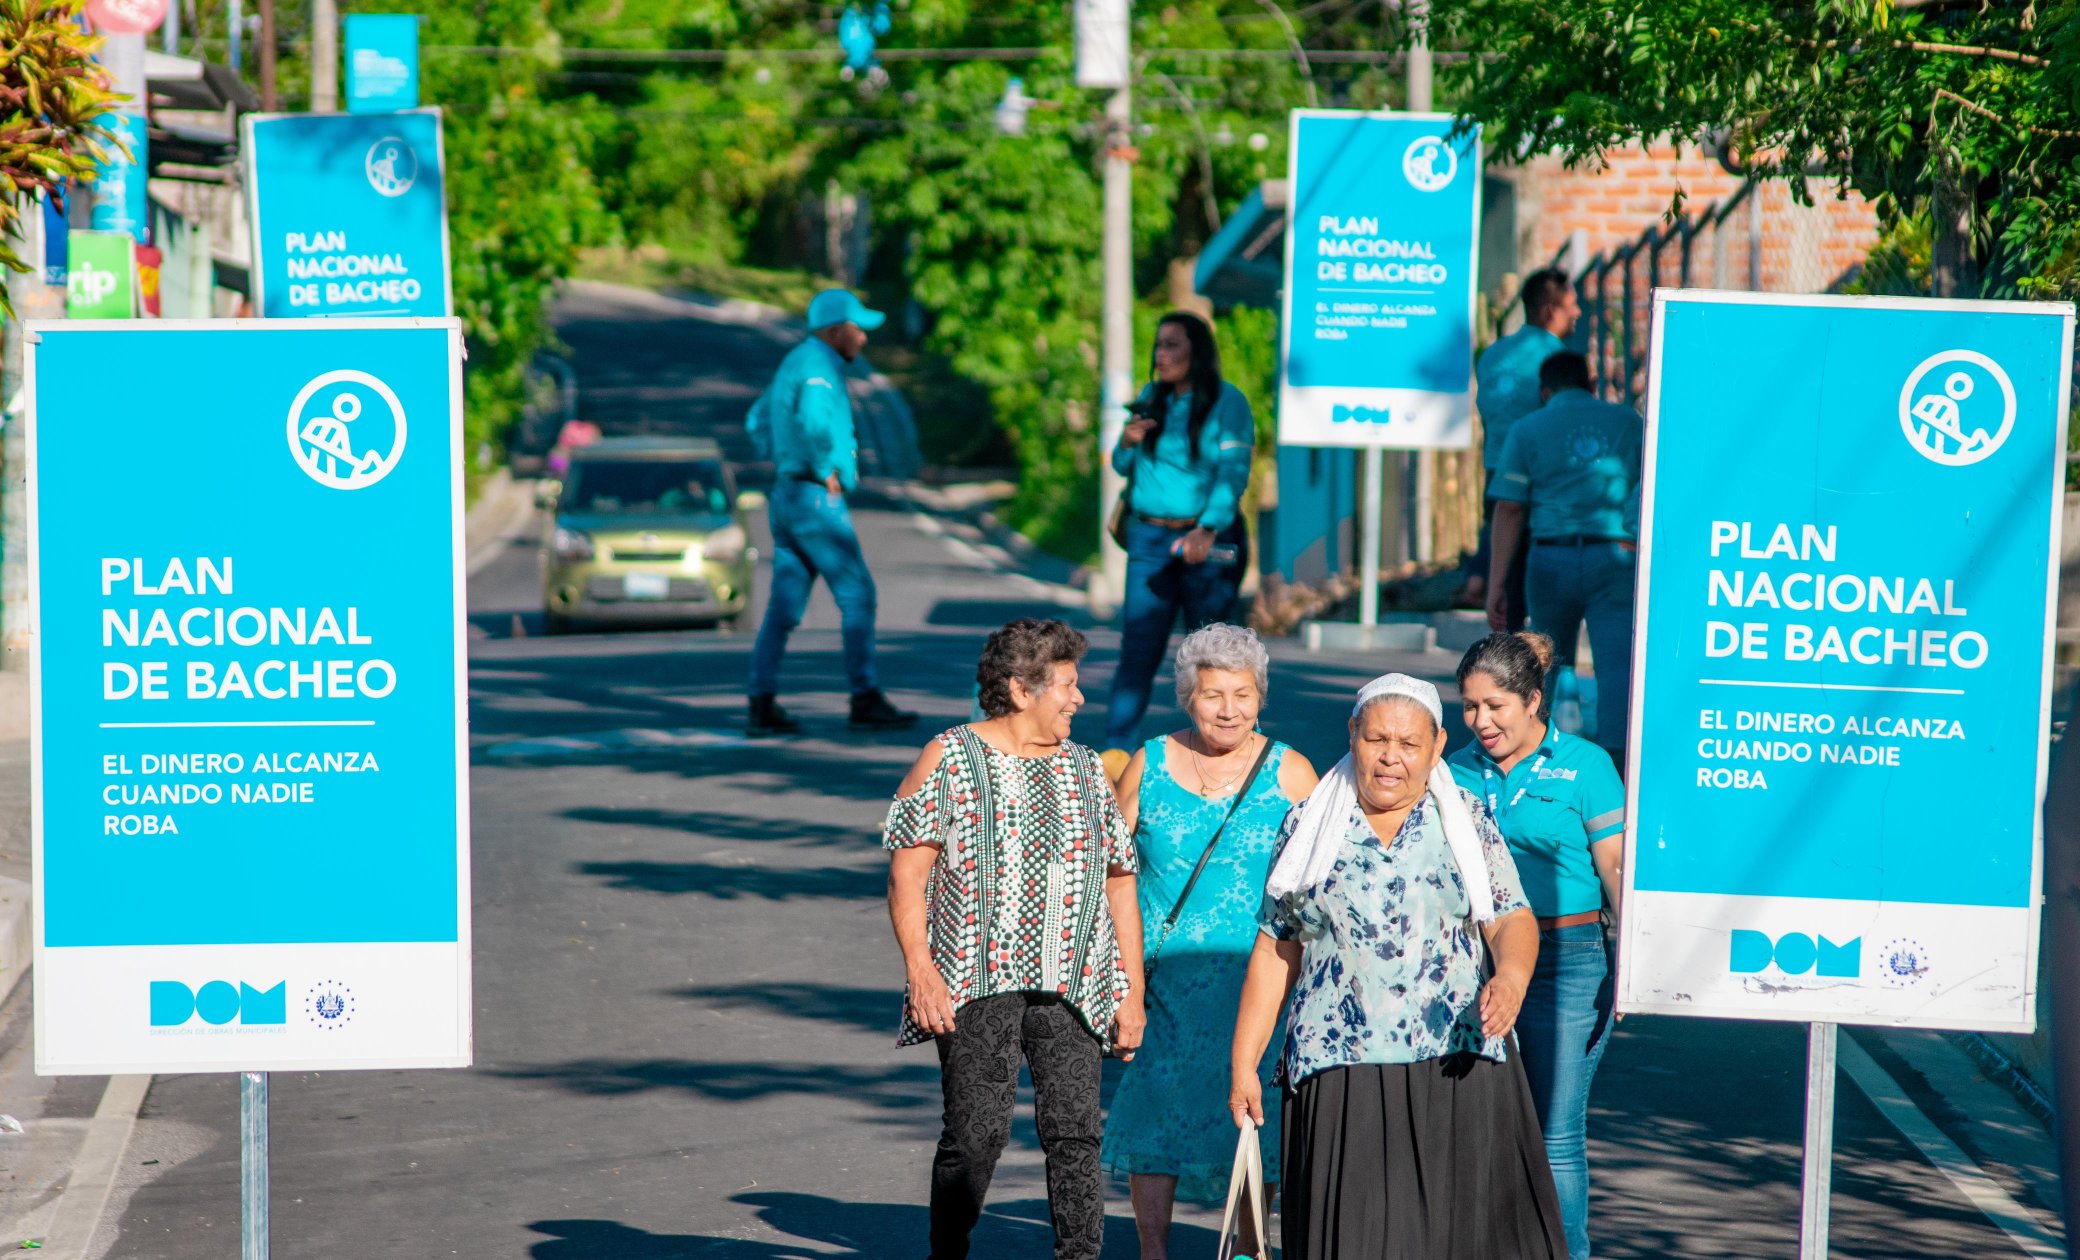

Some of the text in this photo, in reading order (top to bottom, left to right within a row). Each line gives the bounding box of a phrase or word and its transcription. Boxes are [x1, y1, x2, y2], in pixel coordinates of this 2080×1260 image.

[1319, 216, 1378, 236] PLAN
[285, 230, 347, 254] PLAN
[1318, 238, 1436, 260] NACIONAL
[287, 253, 408, 279] NACIONAL
[1317, 261, 1448, 285] DE BACHEO
[289, 278, 421, 307] DE BACHEO
[1711, 520, 1837, 561] PLAN
[102, 556, 233, 595] PLAN
[1708, 570, 1967, 616] NACIONAL
[103, 607, 372, 647] NACIONAL
[1706, 621, 1989, 669] DE BACHEO
[104, 660, 397, 700] DE BACHEO
[1699, 710, 1966, 740] EL DINERO ALCANZA
[103, 752, 380, 775] EL DINERO ALCANZA
[1697, 739, 1901, 767] CUANDO NADIE
[1538, 768, 1578, 781] DOM
[1697, 768, 1768, 790] ROBA
[103, 783, 314, 806] CUANDO NADIE
[104, 815, 179, 836] ROBA
[1730, 929, 1861, 978] DOM
[150, 980, 286, 1026] DOM
